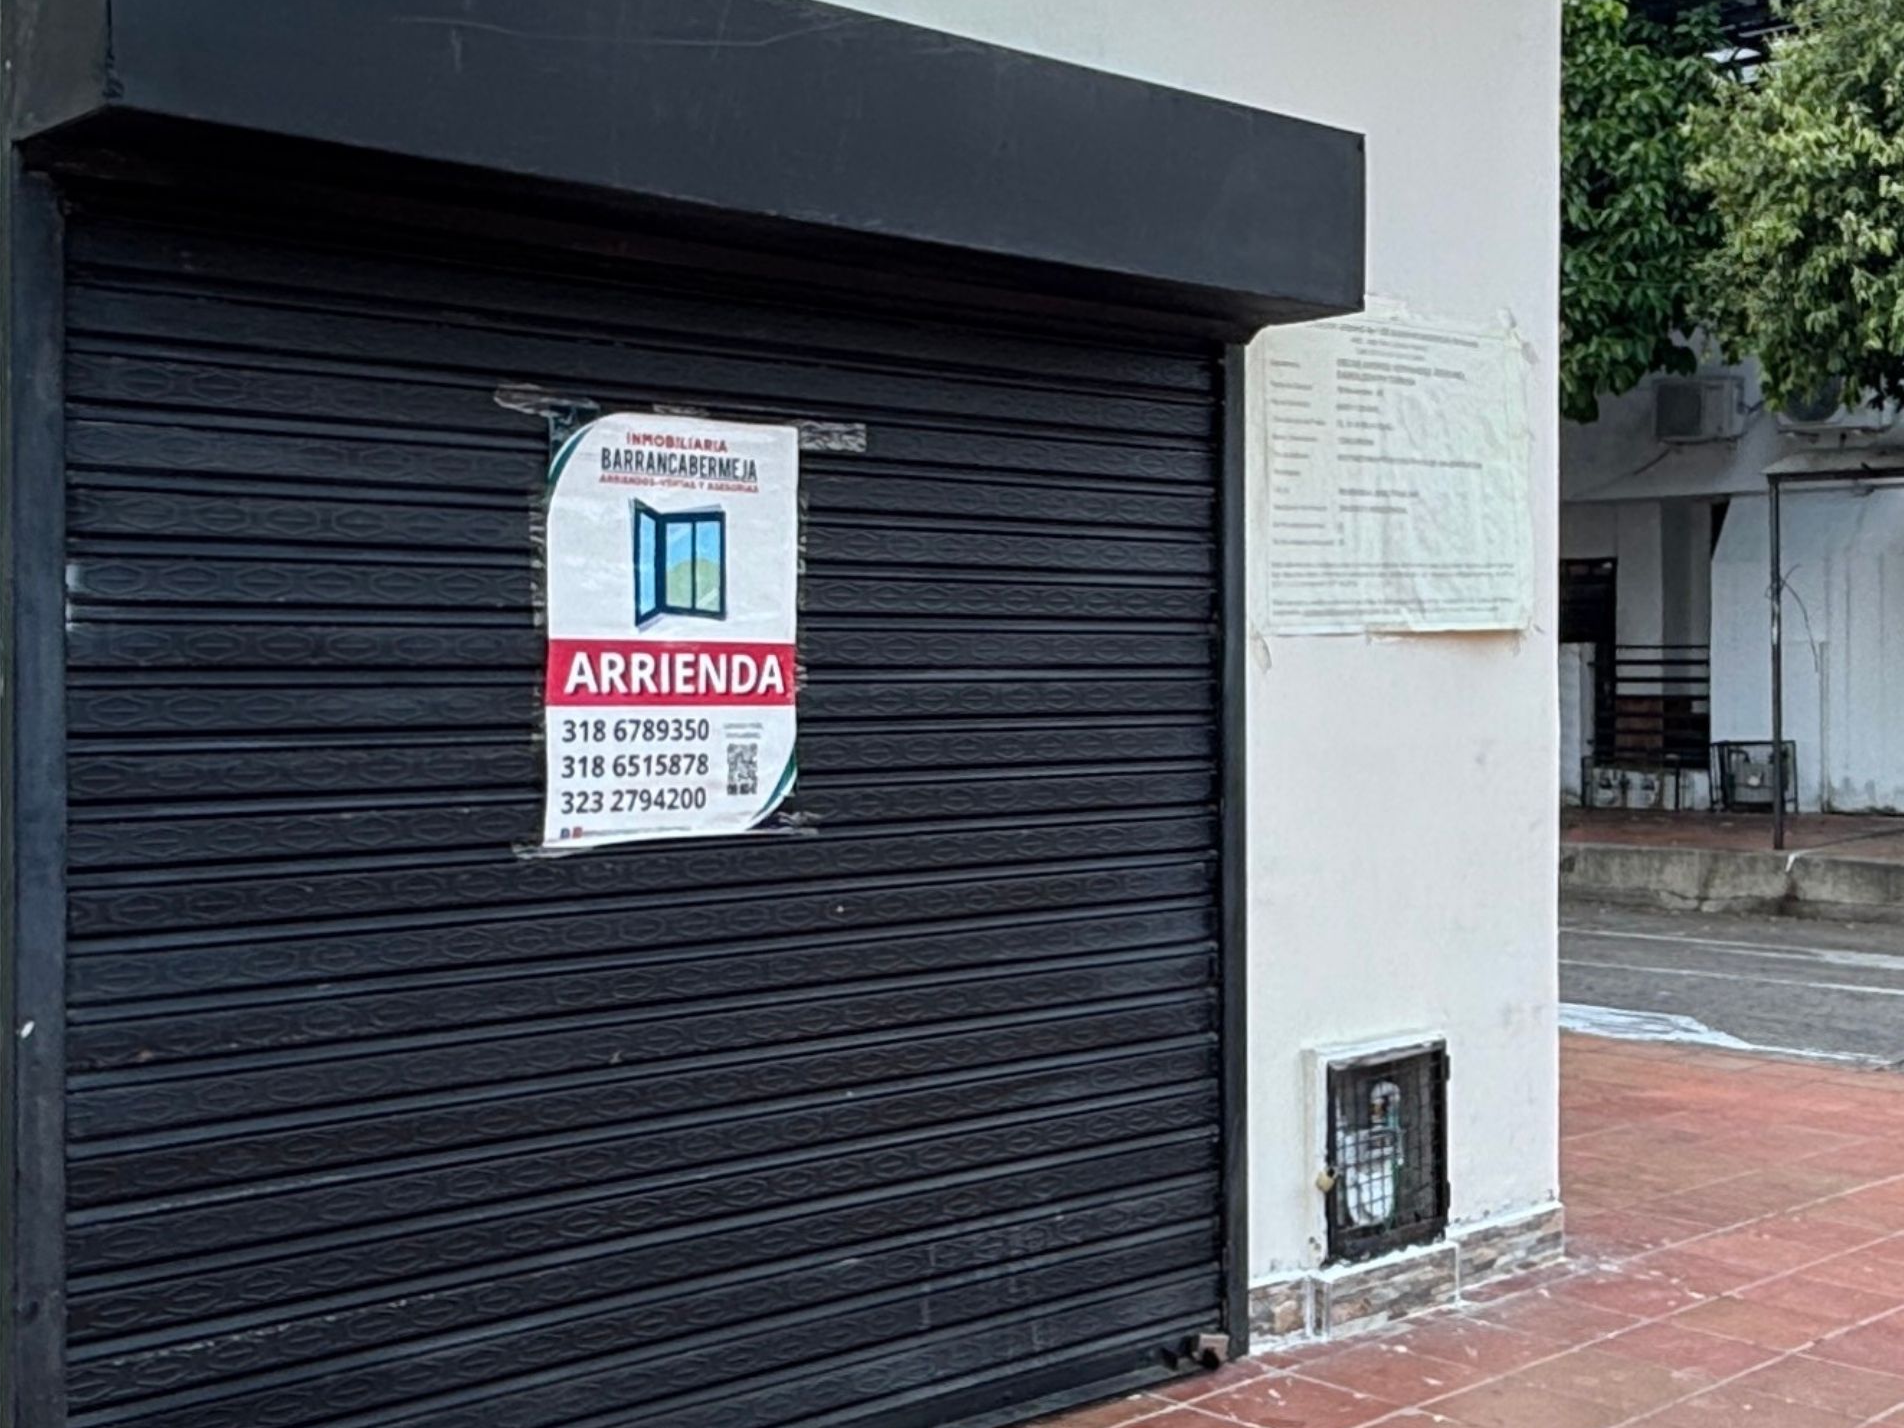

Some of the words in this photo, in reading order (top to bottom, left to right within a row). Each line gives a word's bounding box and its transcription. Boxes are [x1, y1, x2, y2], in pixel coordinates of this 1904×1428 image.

[626, 432, 728, 453] INMOBILIARIA
[600, 447, 758, 483] BARRANCABERMEJA
[564, 651, 786, 696] ARRIENDA
[562, 719, 606, 743] 318
[613, 718, 710, 742] 6789350
[561, 754, 606, 779] 318
[612, 753, 710, 777] 6515878
[561, 790, 604, 814] 323
[610, 787, 707, 812] 2794200
